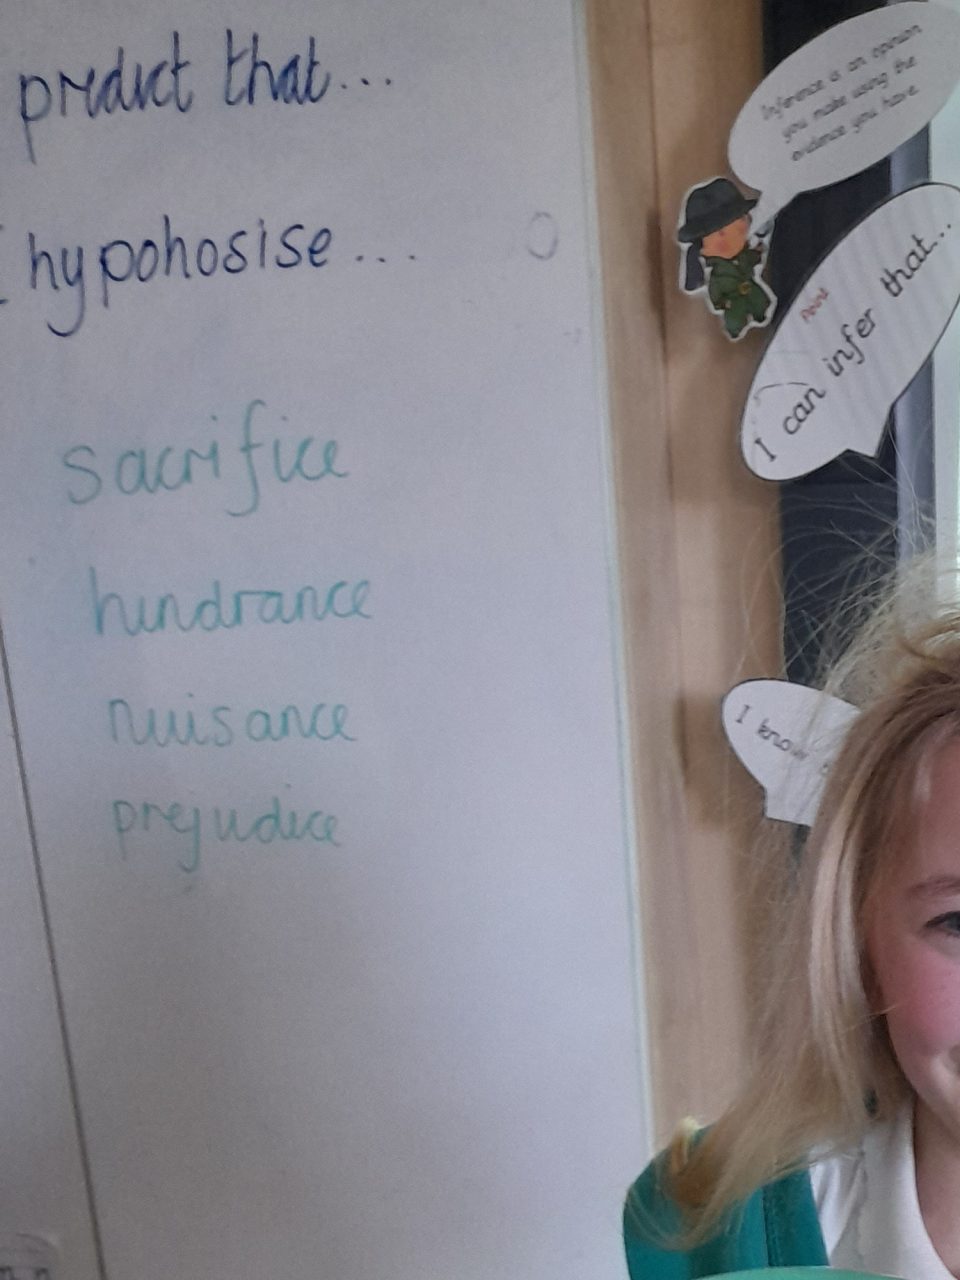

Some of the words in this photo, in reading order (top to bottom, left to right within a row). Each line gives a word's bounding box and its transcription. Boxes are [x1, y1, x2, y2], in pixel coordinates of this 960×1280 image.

[754, 437, 777, 463] I
[782, 387, 826, 436] can
[822, 308, 877, 378] infer
[62, 400, 350, 517] sacrifice
[88, 566, 373, 636] hindrance
[107, 693, 357, 747] nuisance
[735, 704, 750, 724] I
[113, 783, 342, 873] prejudice
